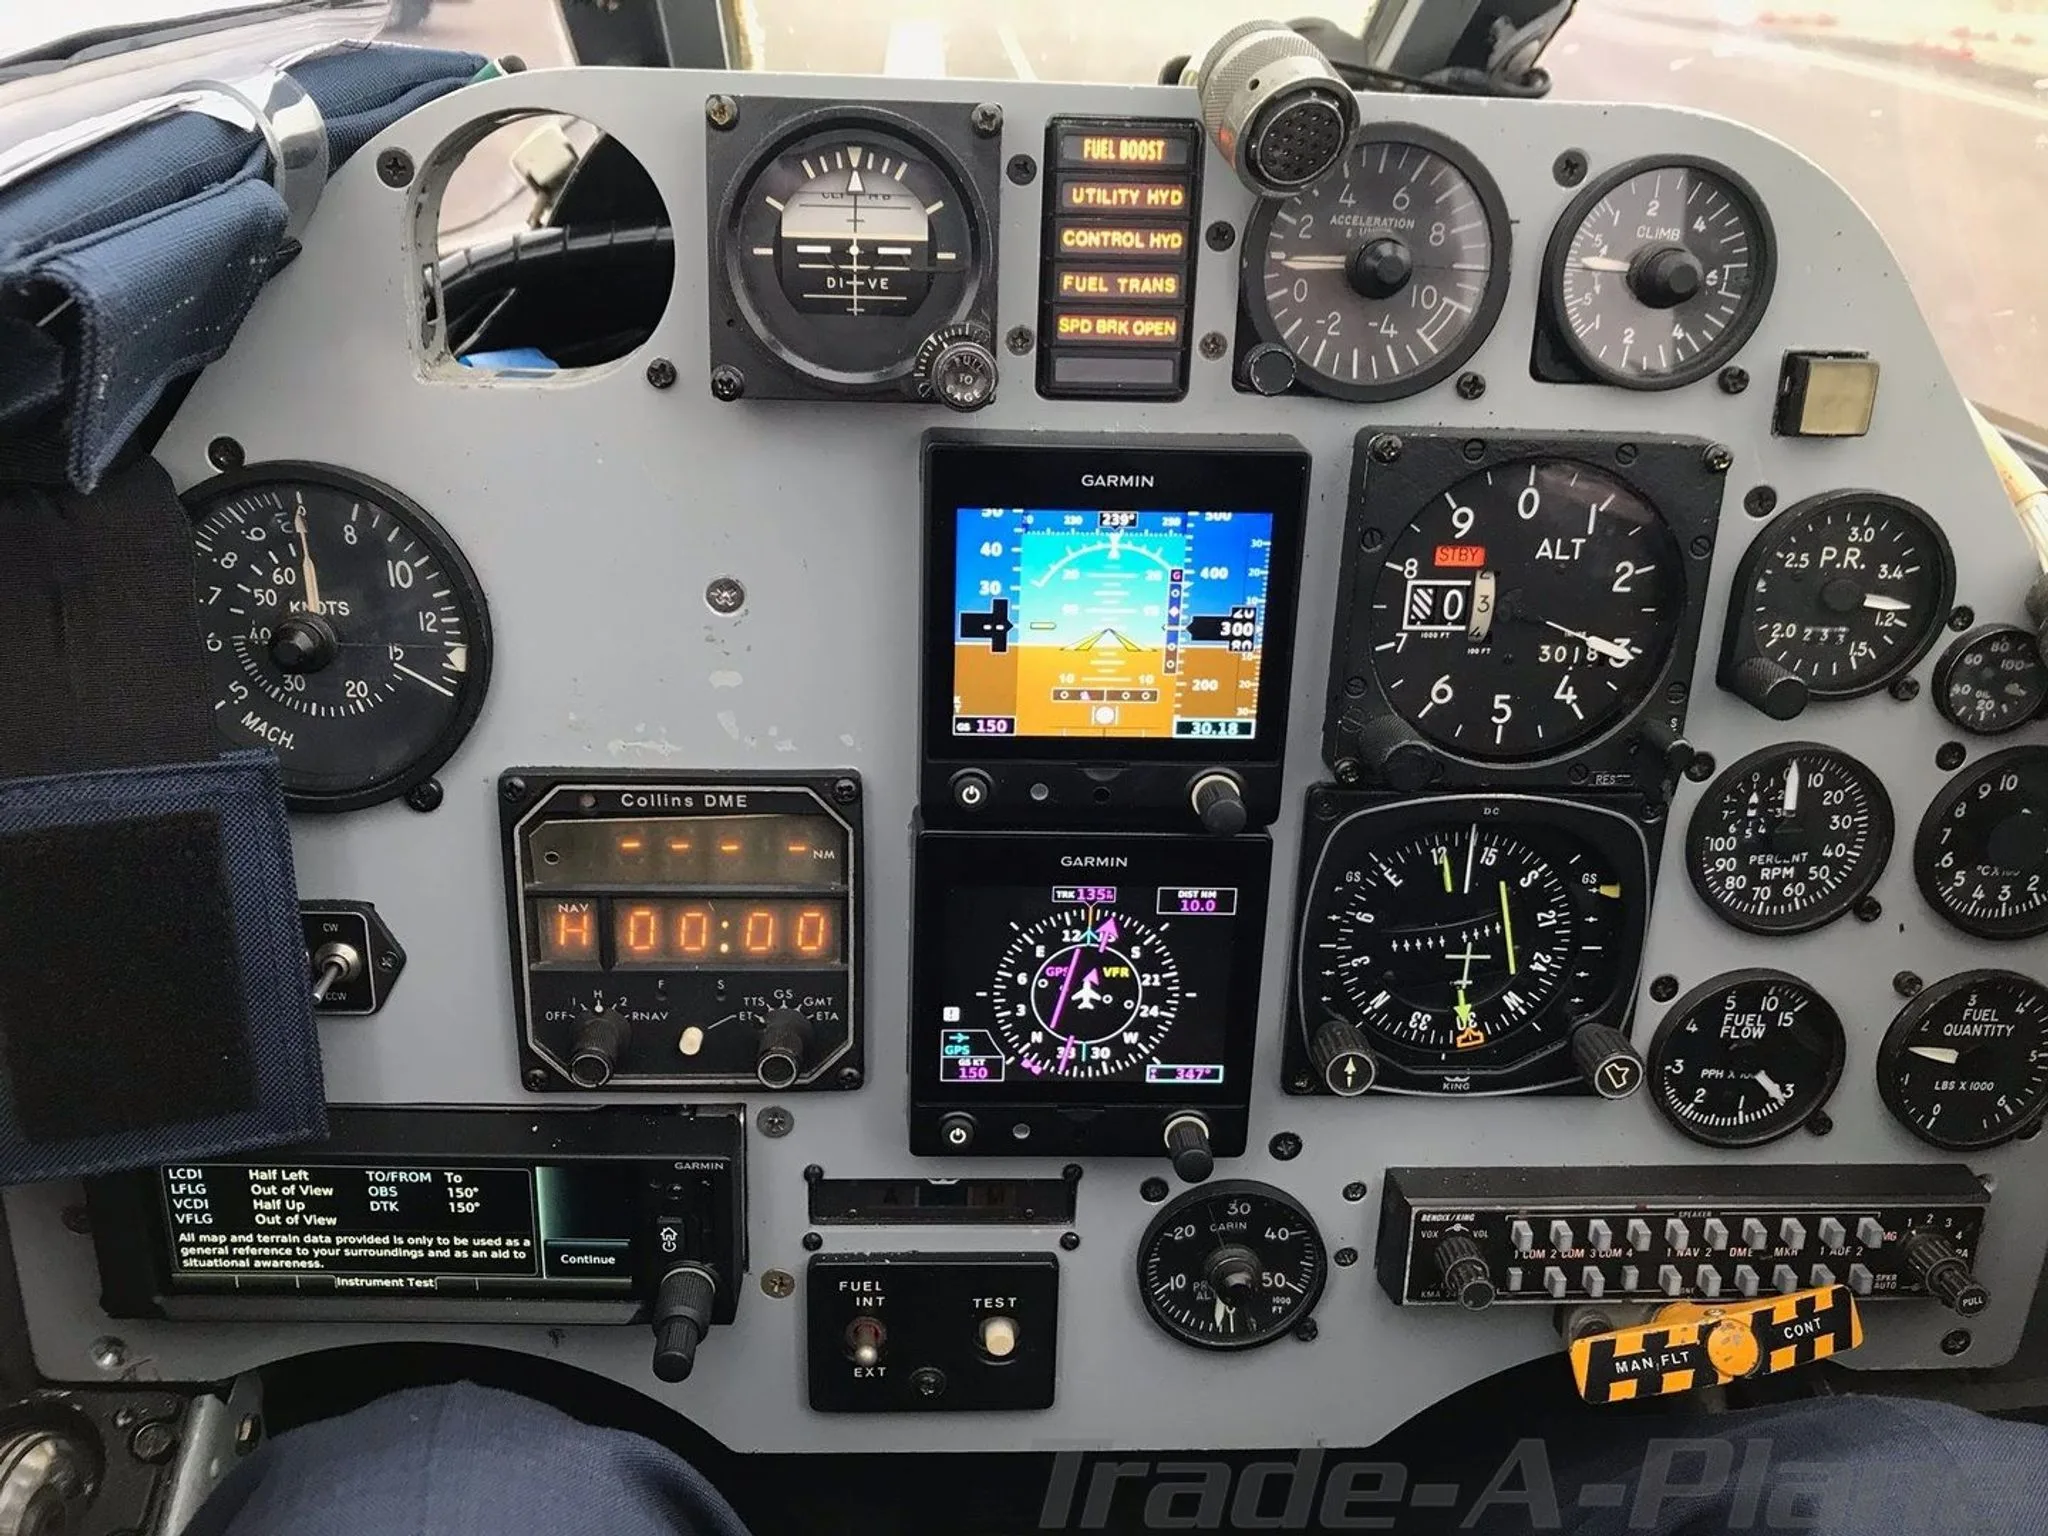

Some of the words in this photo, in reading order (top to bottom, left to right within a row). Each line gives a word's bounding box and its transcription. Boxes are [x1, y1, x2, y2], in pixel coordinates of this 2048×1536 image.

[1083, 139, 1114, 160] FUEL
[1120, 139, 1164, 160] BOOST
[1072, 189, 1140, 205] UTILITY
[1146, 189, 1183, 206] HYD
[1338, 186, 1356, 208] 4
[1392, 187, 1410, 210] 6
[1330, 215, 1415, 230] ACCELERATION
[1062, 230, 1144, 249] CONTROL
[1149, 232, 1182, 250] HYD
[1429, 223, 1445, 246] 8
[1636, 225, 1681, 241] CLIMB
[1062, 276, 1107, 293] FUEL
[1118, 278, 1176, 293] TRANS
[1410, 285, 1438, 310] 10
[1058, 317, 1092, 333] SPD
[1096, 318, 1129, 335] BRK
[1133, 318, 1176, 336] OPEN
[1081, 475, 1154, 488] GARMIN
[1517, 487, 1540, 519] 0
[1101, 513, 1135, 526] 239°
[1848, 526, 1875, 543] 3.0
[979, 541, 1003, 557] 40
[1439, 547, 1479, 561] STBY
[1535, 538, 1586, 560] ALT
[1785, 553, 1810, 569] 2.5
[1819, 546, 1866, 570] P.R.
[272, 566, 296, 585] 60
[387, 559, 413, 589] 10
[1200, 567, 1229, 580] 400
[1878, 565, 1904, 580] 3.4
[978, 579, 1001, 596] 30
[253, 588, 278, 606] 50
[1770, 622, 1797, 639] 2.0
[283, 674, 306, 691] 30
[345, 680, 369, 698] 20
[1192, 679, 1219, 692] 200
[1490, 694, 1512, 724] 5
[976, 719, 1008, 733] 150
[1190, 722, 1239, 736] 30.18
[621, 793, 694, 808] Collins
[705, 794, 748, 808] DME
[1822, 789, 1845, 806] 20
[1829, 815, 1852, 831] 30
[813, 850, 835, 859] NM
[1822, 843, 1846, 858] 40
[1061, 856, 1128, 867] GARMIN
[1715, 857, 1737, 873] 90
[1749, 852, 1809, 866] PERCNT
[1760, 867, 1794, 880] RPM
[1808, 865, 1830, 881] 50
[1725, 875, 1747, 890] 80
[1056, 890, 1075, 899] TRK
[1178, 890, 1198, 899] DIST
[1201, 890, 1217, 899] NM
[1752, 887, 1771, 902] 70
[1782, 882, 1805, 898] 60
[558, 903, 589, 914] NAV
[1180, 900, 1215, 912] 10.0
[323, 922, 339, 932] CW
[1103, 967, 1130, 978] VFR
[1142, 974, 1160, 986] 21
[774, 989, 793, 999] GS
[743, 997, 765, 1007] TTS
[804, 997, 833, 1007] GMT
[545, 1011, 567, 1021] OFF
[632, 1012, 668, 1021] RNAV
[816, 1012, 839, 1021] ETA
[1140, 1005, 1159, 1018] 24
[1962, 1008, 1999, 1022] FUEL
[1723, 1013, 1766, 1027] FUEL
[1720, 1026, 1766, 1039] FLOW
[1943, 1023, 2015, 1037] QUANTITY
[944, 1045, 969, 1055] GPS
[1090, 1047, 1110, 1059] 30
[958, 1067, 988, 1079] 150
[1700, 1068, 1724, 1079] PPH
[1443, 1080, 1470, 1091] KING
[1934, 1081, 1955, 1091] LBS
[1969, 1082, 1994, 1091] 1000
[674, 1162, 724, 1170] GARMIN
[168, 1169, 202, 1180] LCDI
[249, 1169, 277, 1181] Half
[281, 1170, 309, 1181] Left
[365, 1171, 432, 1183] TO/FROM
[444, 1172, 462, 1184] To
[171, 1183, 206, 1195] LFLG
[250, 1184, 277, 1196] Out
[281, 1184, 296, 1196] of
[299, 1185, 334, 1197] View
[368, 1187, 398, 1198] OBS
[446, 1187, 479, 1199] 150°
[173, 1199, 209, 1210] VCDI
[253, 1200, 282, 1211] Half
[285, 1200, 306, 1214] Up
[370, 1201, 399, 1213] DTK
[448, 1201, 481, 1213] 150°
[175, 1214, 213, 1225] VFLG
[255, 1214, 281, 1226] Out
[285, 1214, 300, 1226] of
[303, 1215, 337, 1227] View
[1421, 1213, 1475, 1222] BENDIX/KING
[1173, 1224, 1196, 1240] 20
[1264, 1227, 1290, 1241] 40
[179, 1233, 195, 1243] All
[199, 1234, 226, 1246] map
[230, 1234, 253, 1244] and
[257, 1234, 299, 1244] terrain
[303, 1234, 331, 1245] data
[335, 1235, 390, 1247] provided
[394, 1236, 403, 1245] is
[407, 1236, 433, 1248] only
[436, 1236, 450, 1246] to
[453, 1236, 469, 1246] be
[473, 1236, 502, 1247] used
[505, 1237, 519, 1247] as
[523, 1238, 531, 1247] a
[180, 1246, 229, 1257] general
[233, 1246, 292, 1256] reference
[296, 1247, 309, 1256] to
[313, 1247, 340, 1258] your
[344, 1247, 424, 1260] surroundings
[428, 1248, 450, 1258] and
[454, 1250, 468, 1259] as
[471, 1250, 487, 1259] an
[490, 1248, 509, 1259] aid
[513, 1249, 526, 1259] to
[560, 1254, 616, 1265] Continue
[1522, 1249, 1546, 1259] COM
[1561, 1249, 1584, 1259] COM
[1599, 1249, 1622, 1258] COM
[1677, 1247, 1700, 1258] NAV
[182, 1258, 250, 1268] situational
[254, 1259, 325, 1269] awareness.
[336, 1277, 404, 1288] Instrument
[406, 1278, 434, 1288] Test
[839, 1281, 883, 1292] FUEL
[1262, 1272, 1286, 1287] 50
[856, 1296, 885, 1307] INT
[972, 1297, 1017, 1308] TEST
[1963, 1296, 1983, 1307] PULL
[1783, 1318, 1822, 1340] CONT
[1615, 1356, 1654, 1374] MAN
[1661, 1351, 1690, 1366] FLT
[853, 1367, 888, 1377] EXT
